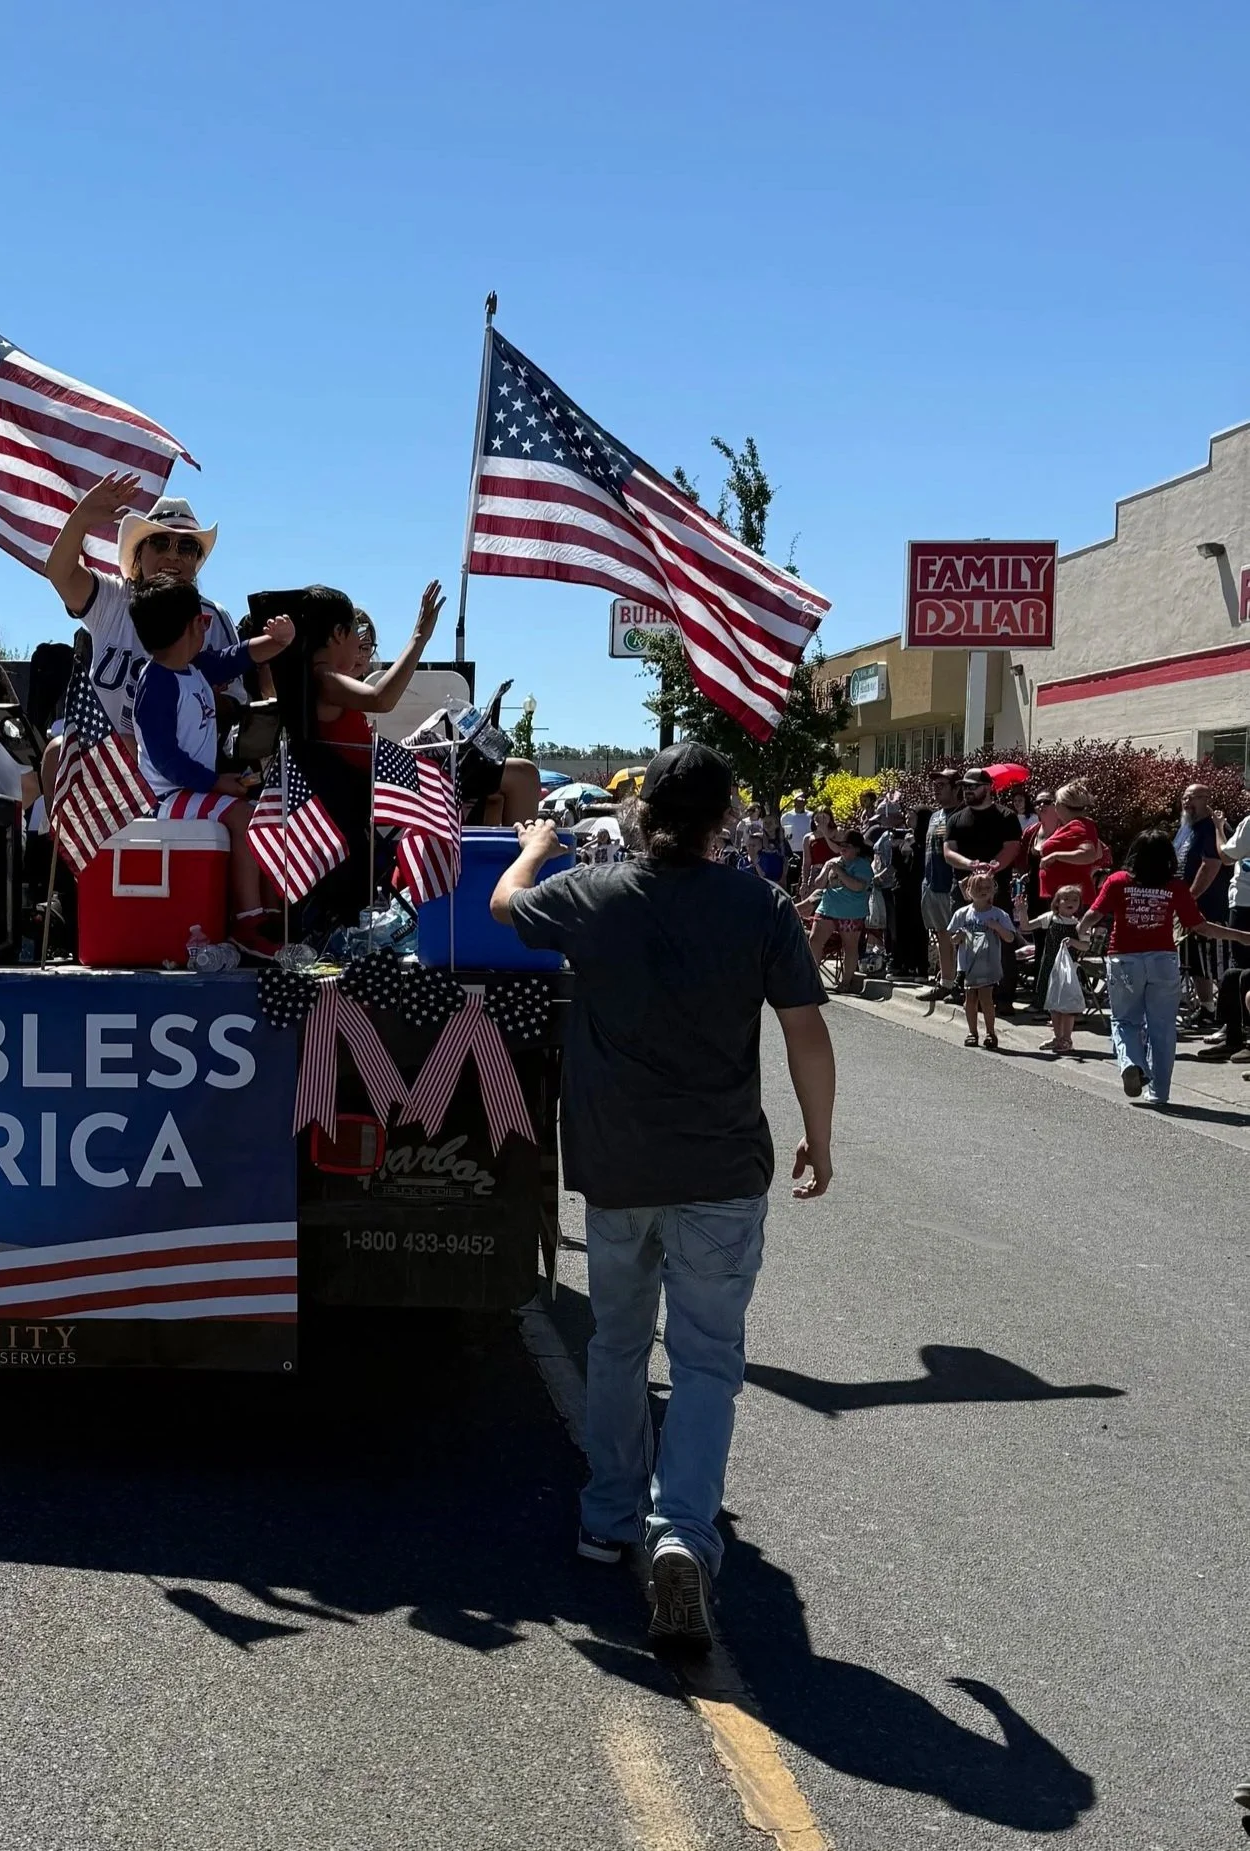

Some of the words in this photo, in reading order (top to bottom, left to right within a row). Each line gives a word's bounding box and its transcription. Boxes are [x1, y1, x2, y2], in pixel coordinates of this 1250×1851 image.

[916, 555, 1054, 592] FAMILY
[915, 598, 1047, 636] DOLLAR
[357, 1134, 496, 1195] arbor
[342, 1229, 397, 1251] 1-800
[402, 1232, 495, 1255] 433-9452
[0, 1351, 77, 1365] SERVICES
